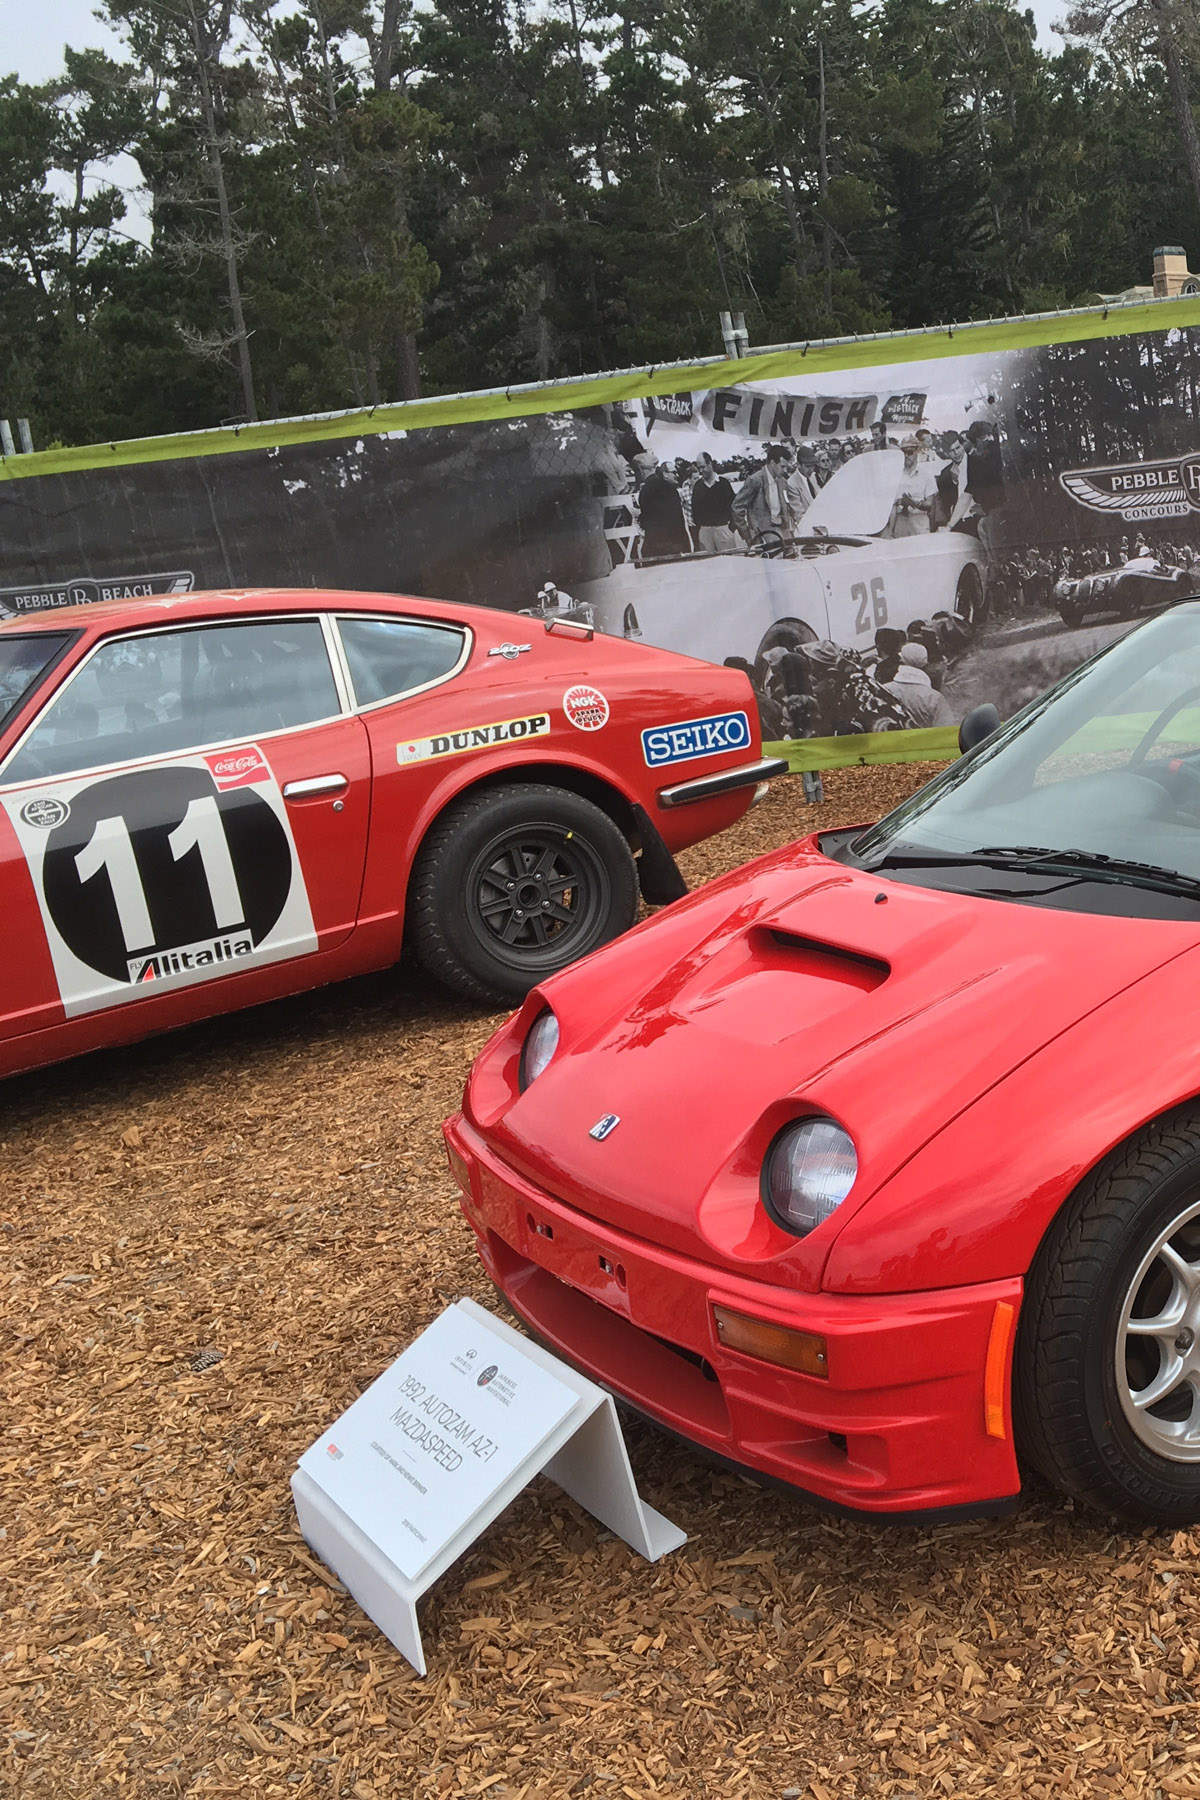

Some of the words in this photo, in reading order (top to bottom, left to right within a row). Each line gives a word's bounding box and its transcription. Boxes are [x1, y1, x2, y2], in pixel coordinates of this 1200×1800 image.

[712, 392, 870, 437] FINISH
[1111, 470, 1180, 491] PEBBLE
[1124, 504, 1188, 519] CONCOURS
[15, 592, 68, 609] PEBBLE
[102, 584, 153, 601] BEACH
[851, 576, 888, 635] 26
[570, 695, 598, 708] NGK
[576, 708, 600, 716] SPARK
[431, 716, 546, 755] DUNLOP
[648, 718, 745, 760] SEIKO
[74, 796, 245, 952] 11
[129, 961, 143, 971] FLY
[135, 939, 252, 984] Alitalia
[398, 1374, 426, 1403] 1992
[418, 1394, 477, 1445] AUTOZAM
[466, 1435, 499, 1463] AZ-1
[389, 1406, 463, 1472] MAZDASPEED
